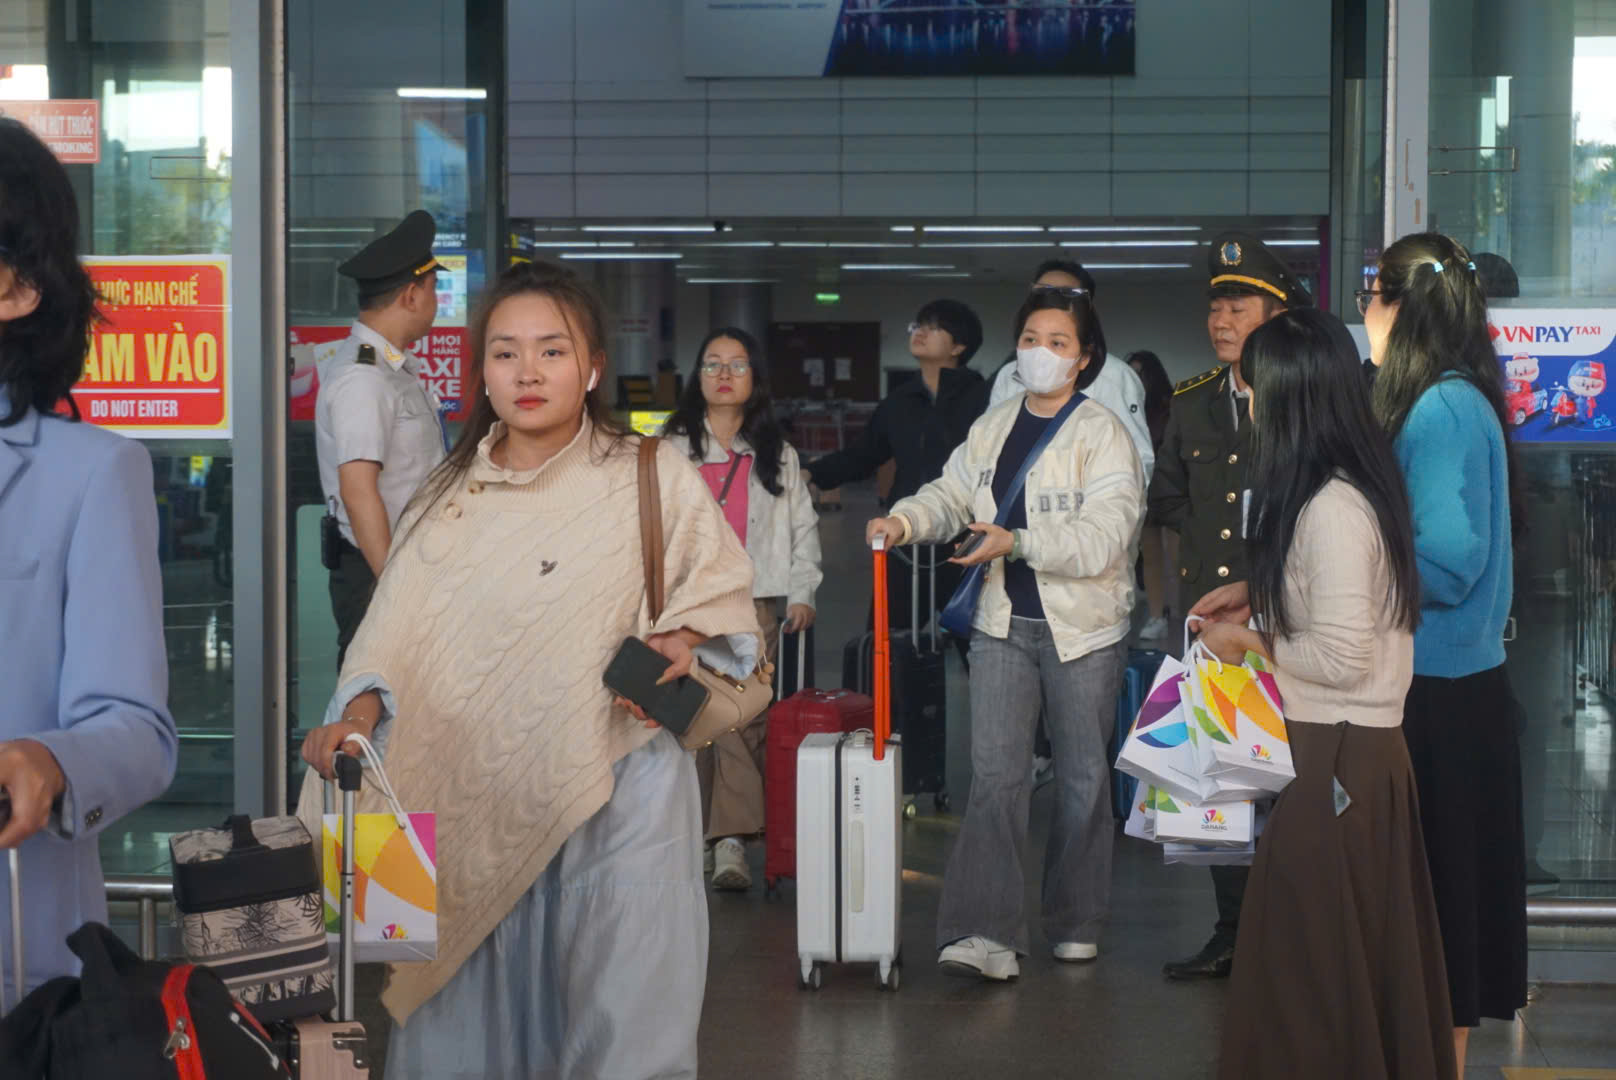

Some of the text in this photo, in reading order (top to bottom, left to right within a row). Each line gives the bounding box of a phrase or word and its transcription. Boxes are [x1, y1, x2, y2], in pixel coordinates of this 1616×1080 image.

[133, 281, 165, 311] HẠN
[169, 273, 199, 306] CHẾ
[1502, 326, 1601, 343] VNPAY TAXI
[144, 322, 217, 383] VÀO
[417, 357, 461, 377] AXI
[91, 400, 178, 417] DO NOT ENTER
